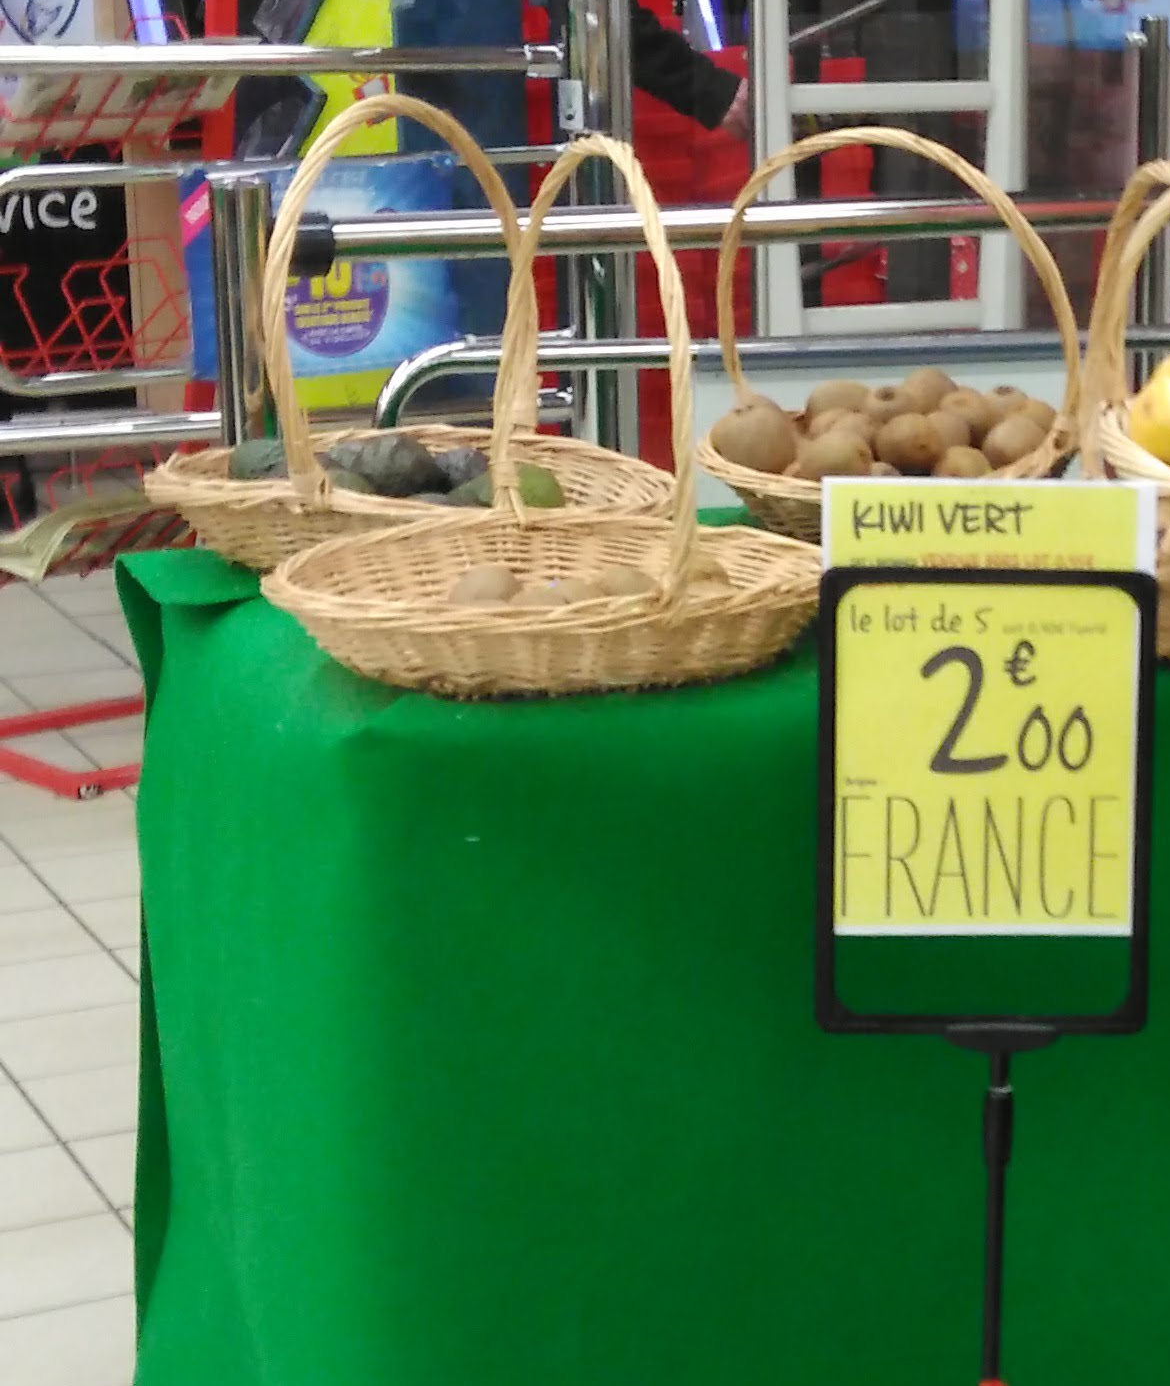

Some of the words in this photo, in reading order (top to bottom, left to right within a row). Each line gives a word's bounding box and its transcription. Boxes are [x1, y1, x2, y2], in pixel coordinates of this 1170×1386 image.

[852, 499, 925, 539] KIWI
[937, 501, 1033, 534] VERT
[849, 603, 872, 633] le
[884, 604, 920, 633] lot
[930, 602, 962, 634] de
[839, 795, 1119, 919] FRANCE
